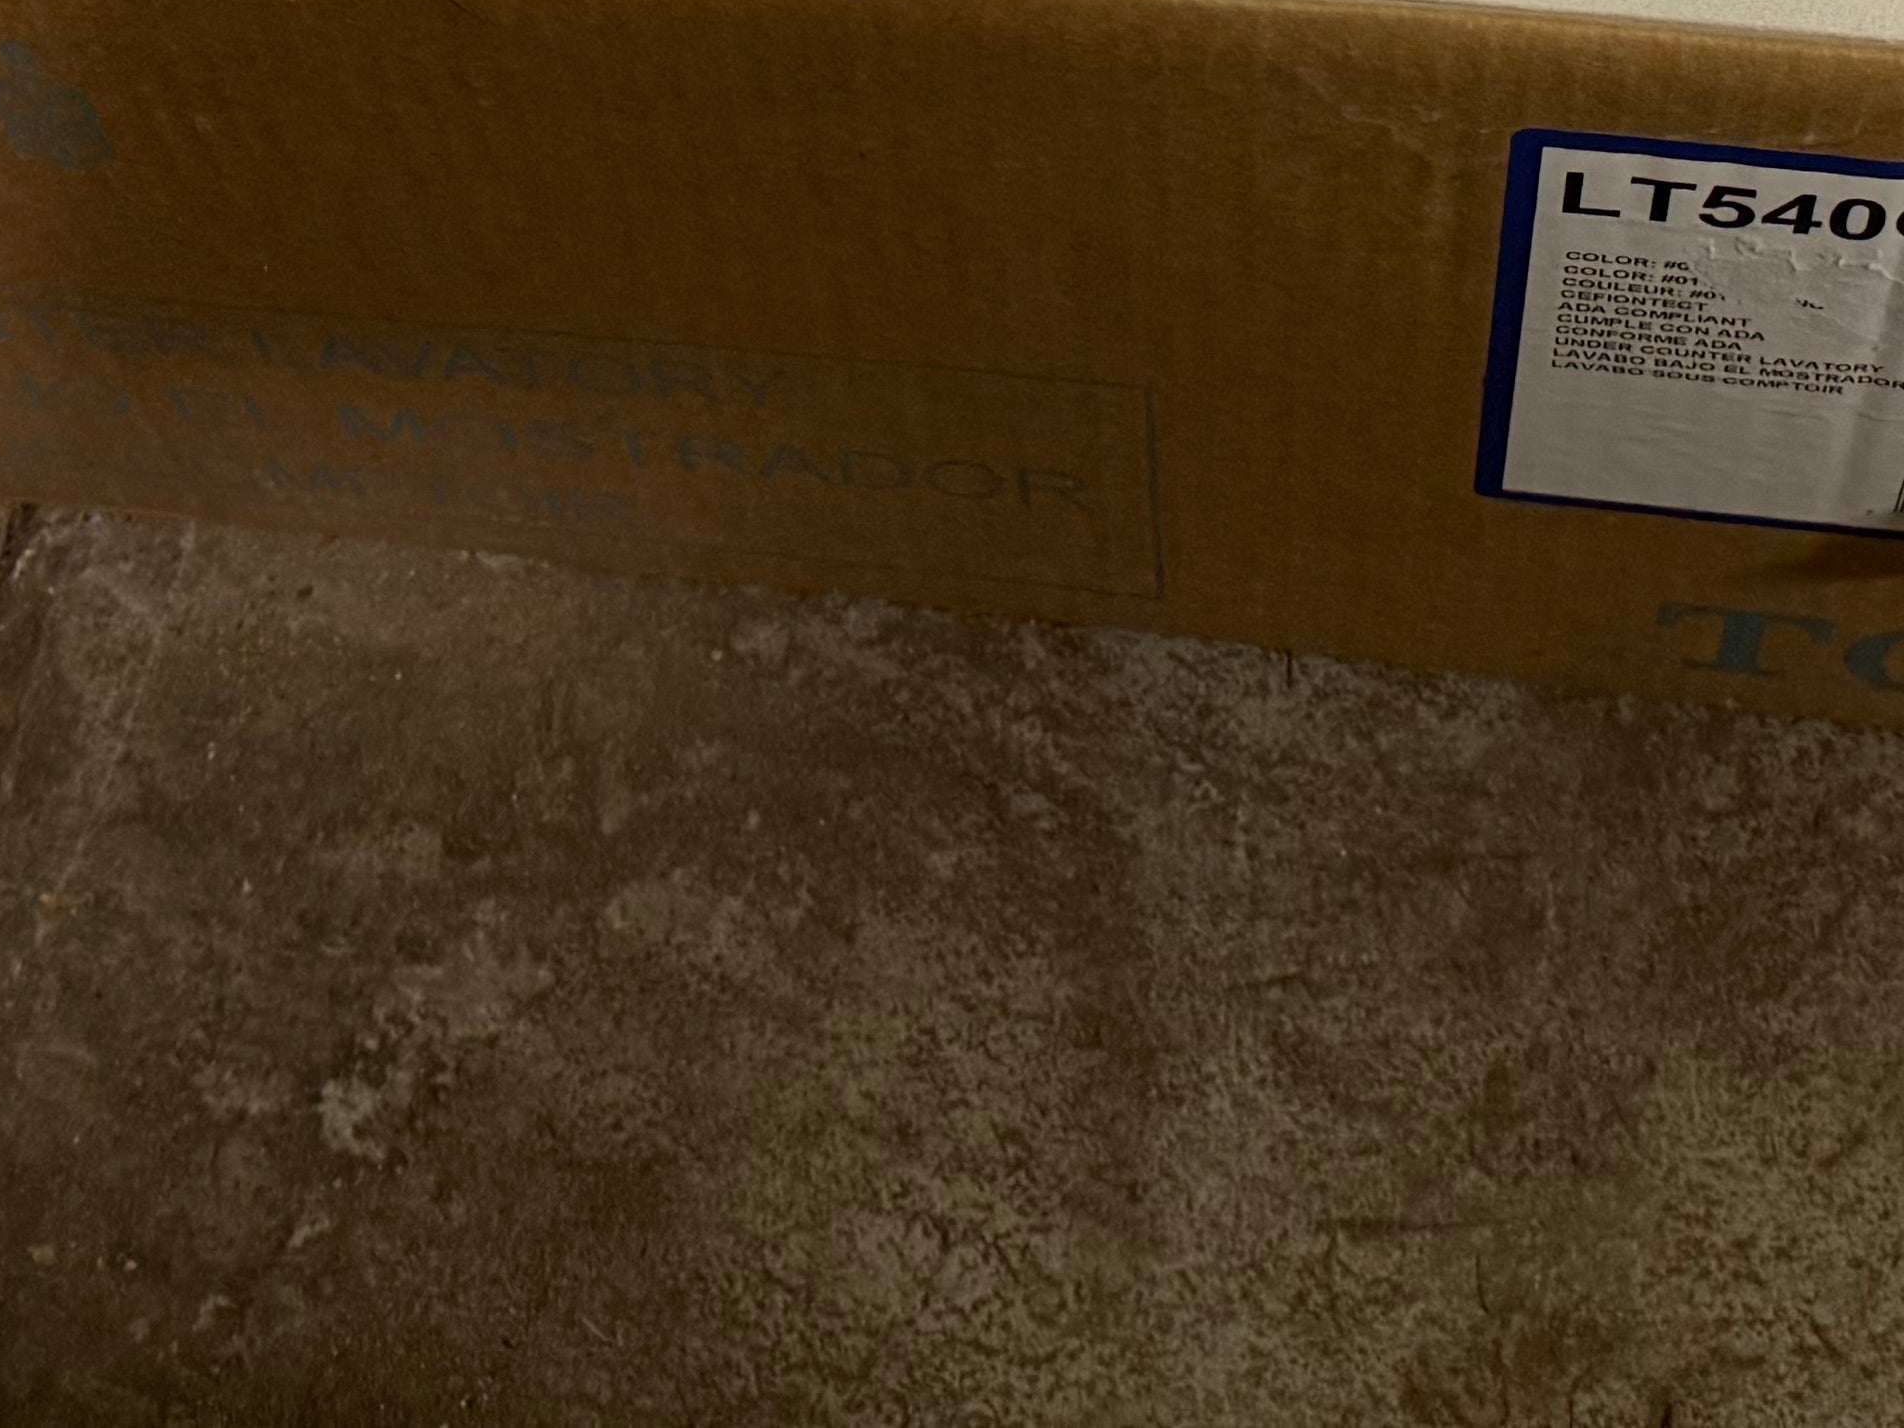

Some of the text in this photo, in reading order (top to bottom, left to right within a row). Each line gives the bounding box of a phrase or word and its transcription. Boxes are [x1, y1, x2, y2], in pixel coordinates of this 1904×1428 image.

[1565, 250, 1657, 269] COLOR:
[1562, 264, 1655, 283] COLOR:
[1560, 289, 1708, 312] CEFIONTECT
[1561, 277, 1683, 298] COULEUR:
[1556, 313, 1765, 342] CUMPLE CON ADA
[1557, 301, 1752, 328] ADA COMPLIANT
[1555, 325, 1743, 351] CONFORME ADA
[1552, 347, 1646, 366] LAVABO
[1653, 357, 1716, 372] BAJO
[1723, 363, 1752, 376] EL
[1554, 336, 1885, 374] UNDER COUNTER LAVATORY
[1551, 359, 1844, 395] LAVABO SOUS COMPTOIR
